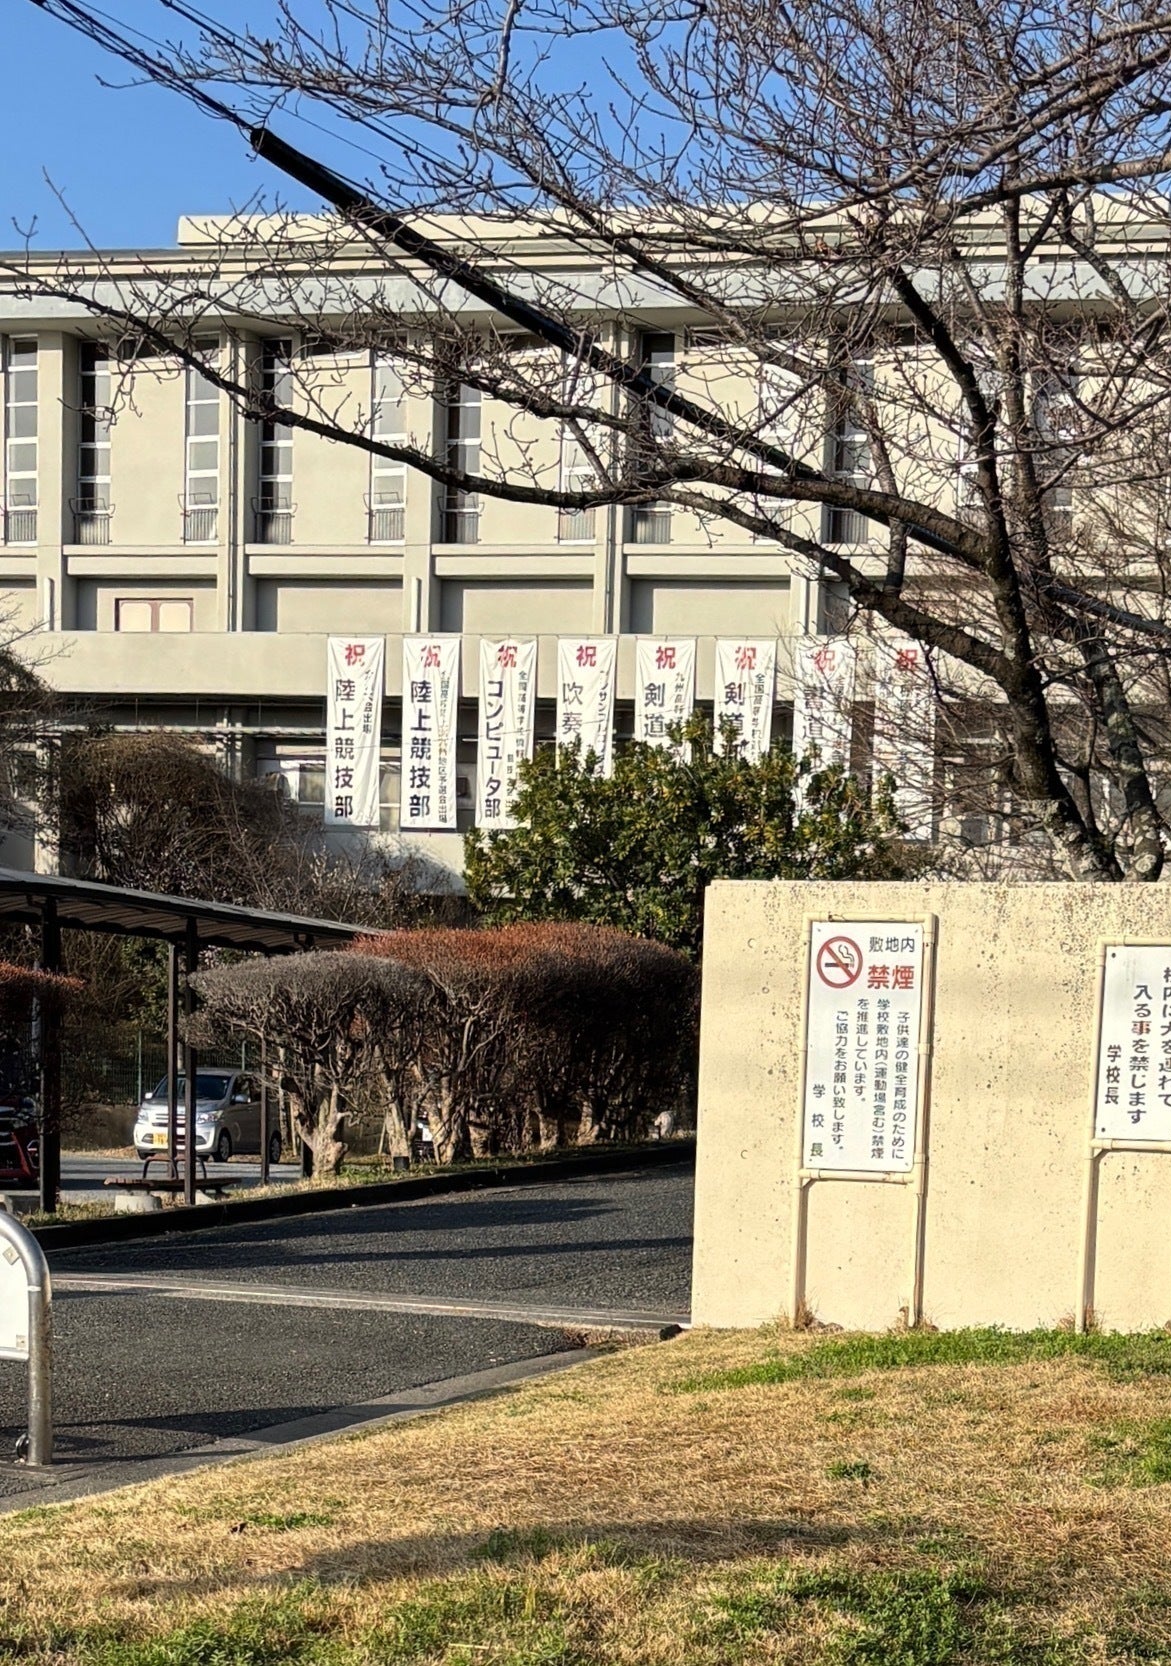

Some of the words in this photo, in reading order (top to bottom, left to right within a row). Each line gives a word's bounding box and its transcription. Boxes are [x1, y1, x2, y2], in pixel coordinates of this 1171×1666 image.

[345, 644, 366, 667] 祝
[576, 645, 597, 667] 祝
[656, 646, 676, 669] 祝
[334, 679, 355, 818] 陸上競技部
[410, 680, 432, 818] 陸上競技部
[485, 680, 504, 819] コンピュータ部
[867, 964, 915, 990] 禁煙
[869, 936, 915, 953] 敷地内
[831, 1010, 849, 1151] ご協力をお願い致します。
[854, 998, 870, 1102] を推進しています。
[891, 1011, 910, 1160] 子供達の健全育成のために
[1105, 1044, 1122, 1105] 学校長
[1127, 984, 1153, 1124] 入る事を禁じます
